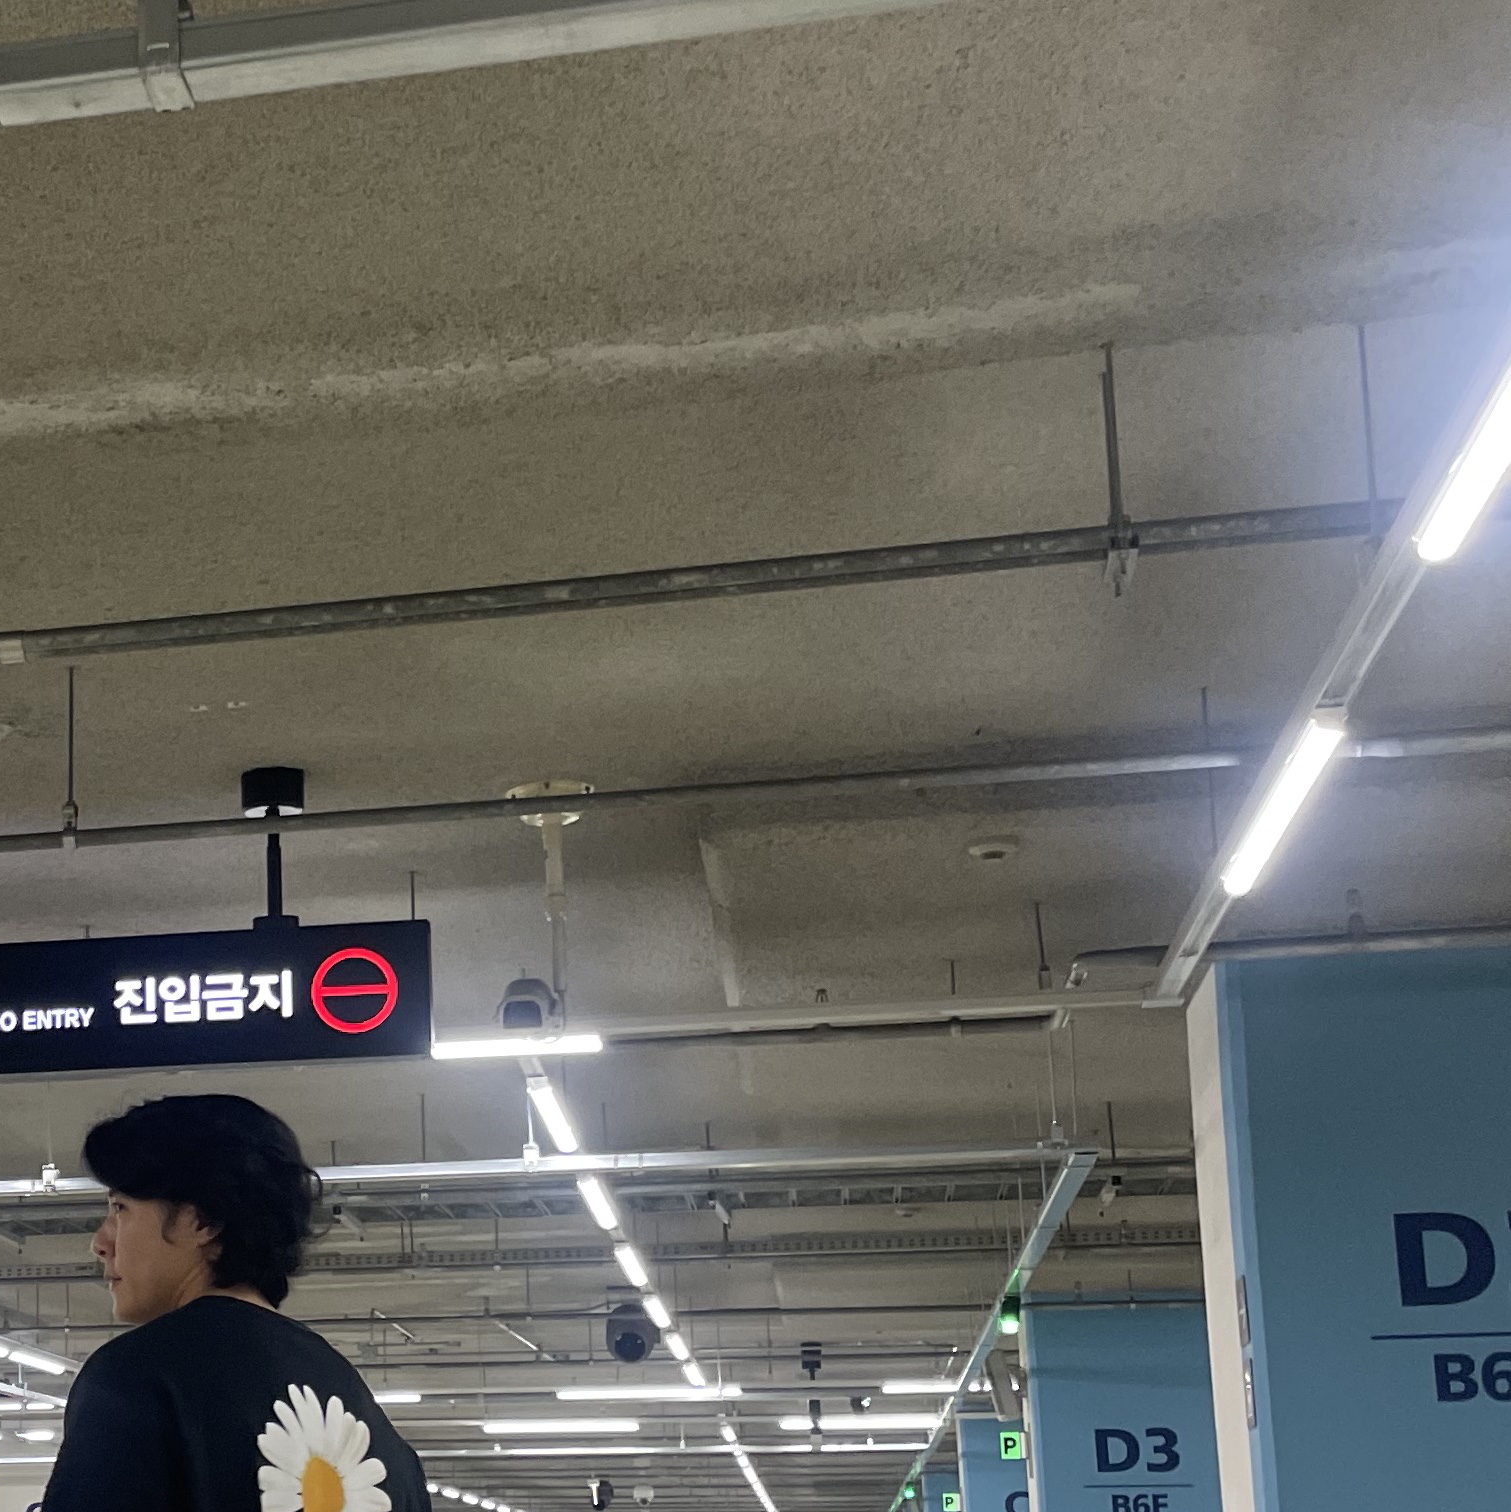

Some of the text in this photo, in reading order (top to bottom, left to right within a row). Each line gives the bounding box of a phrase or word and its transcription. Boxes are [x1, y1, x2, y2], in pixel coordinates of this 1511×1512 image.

[22, 1007, 95, 1031] ENTRY
[112, 968, 294, 1025] 진입금지
[1393, 1210, 1511, 1307] D
[1003, 1437, 1017, 1455] P
[1094, 1427, 1180, 1473] D3
[945, 1497, 954, 1508] P
